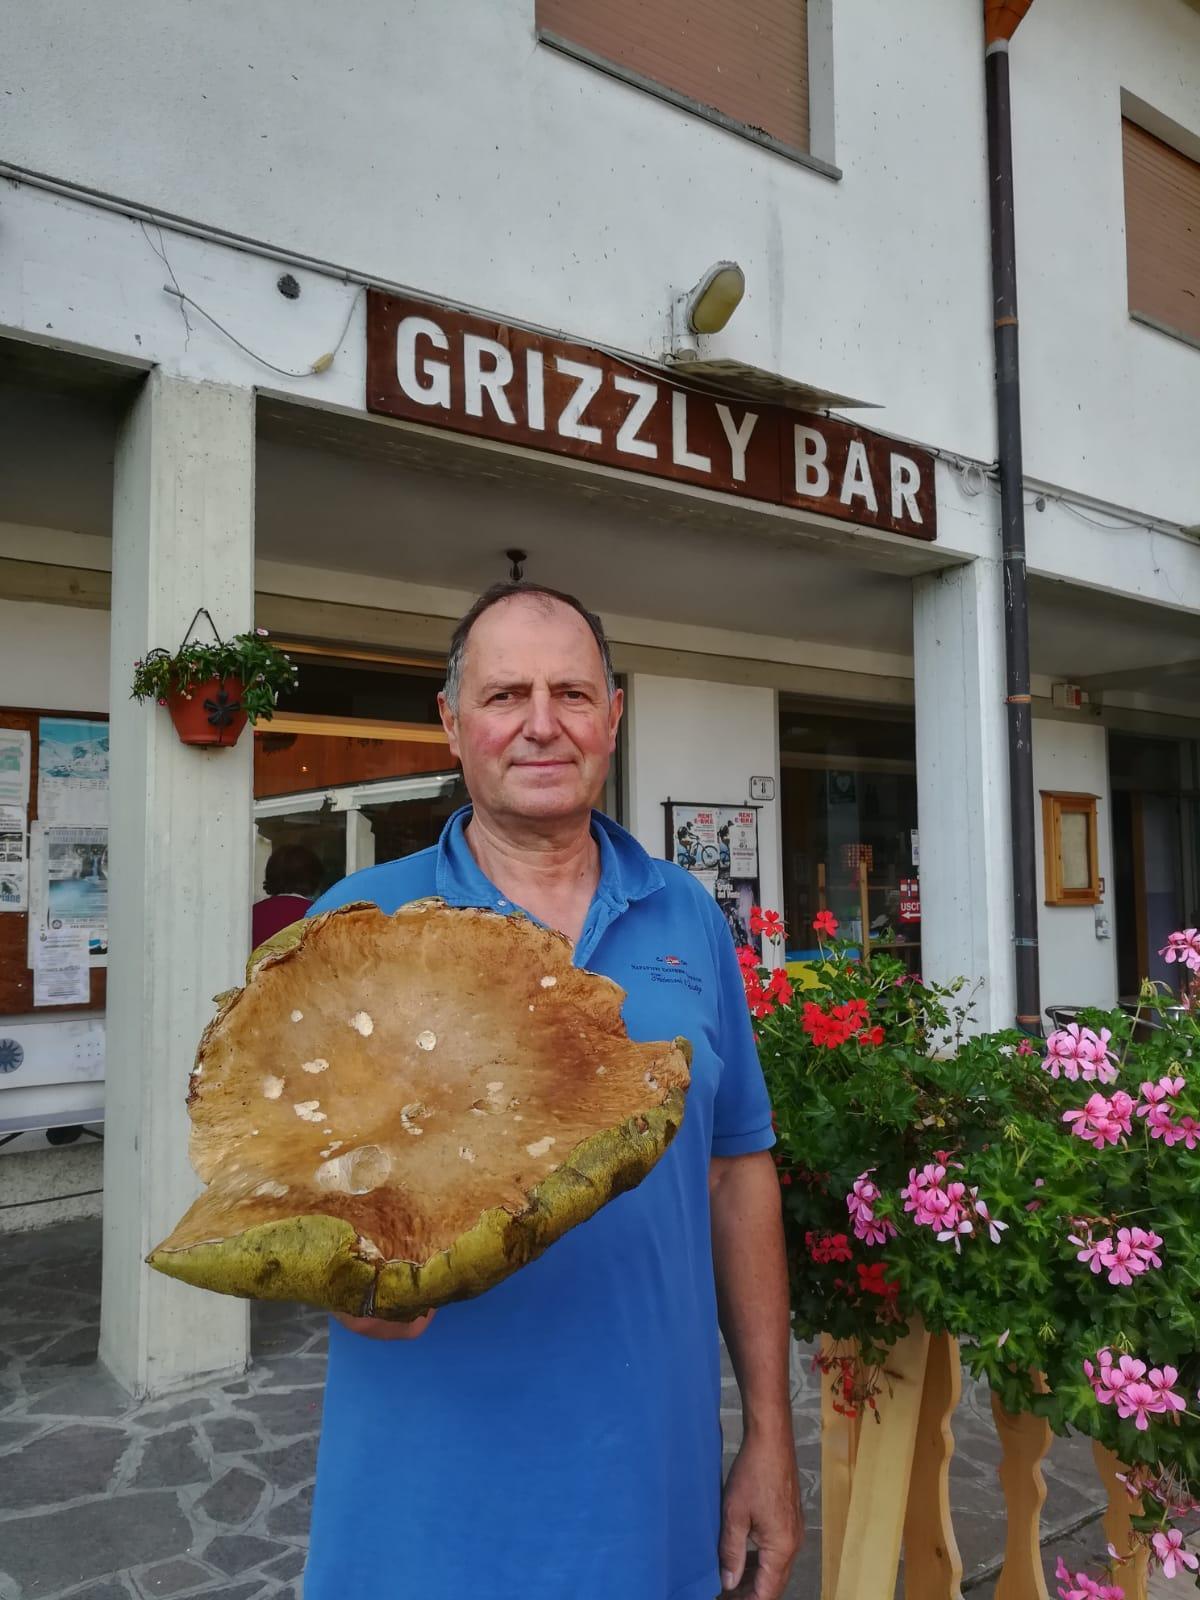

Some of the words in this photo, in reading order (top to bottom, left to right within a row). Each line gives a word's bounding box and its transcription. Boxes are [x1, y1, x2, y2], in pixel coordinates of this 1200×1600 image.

[396, 315, 758, 482] GRIZZLY
[793, 423, 924, 526] BAR
[900, 902, 921, 911] USCI
